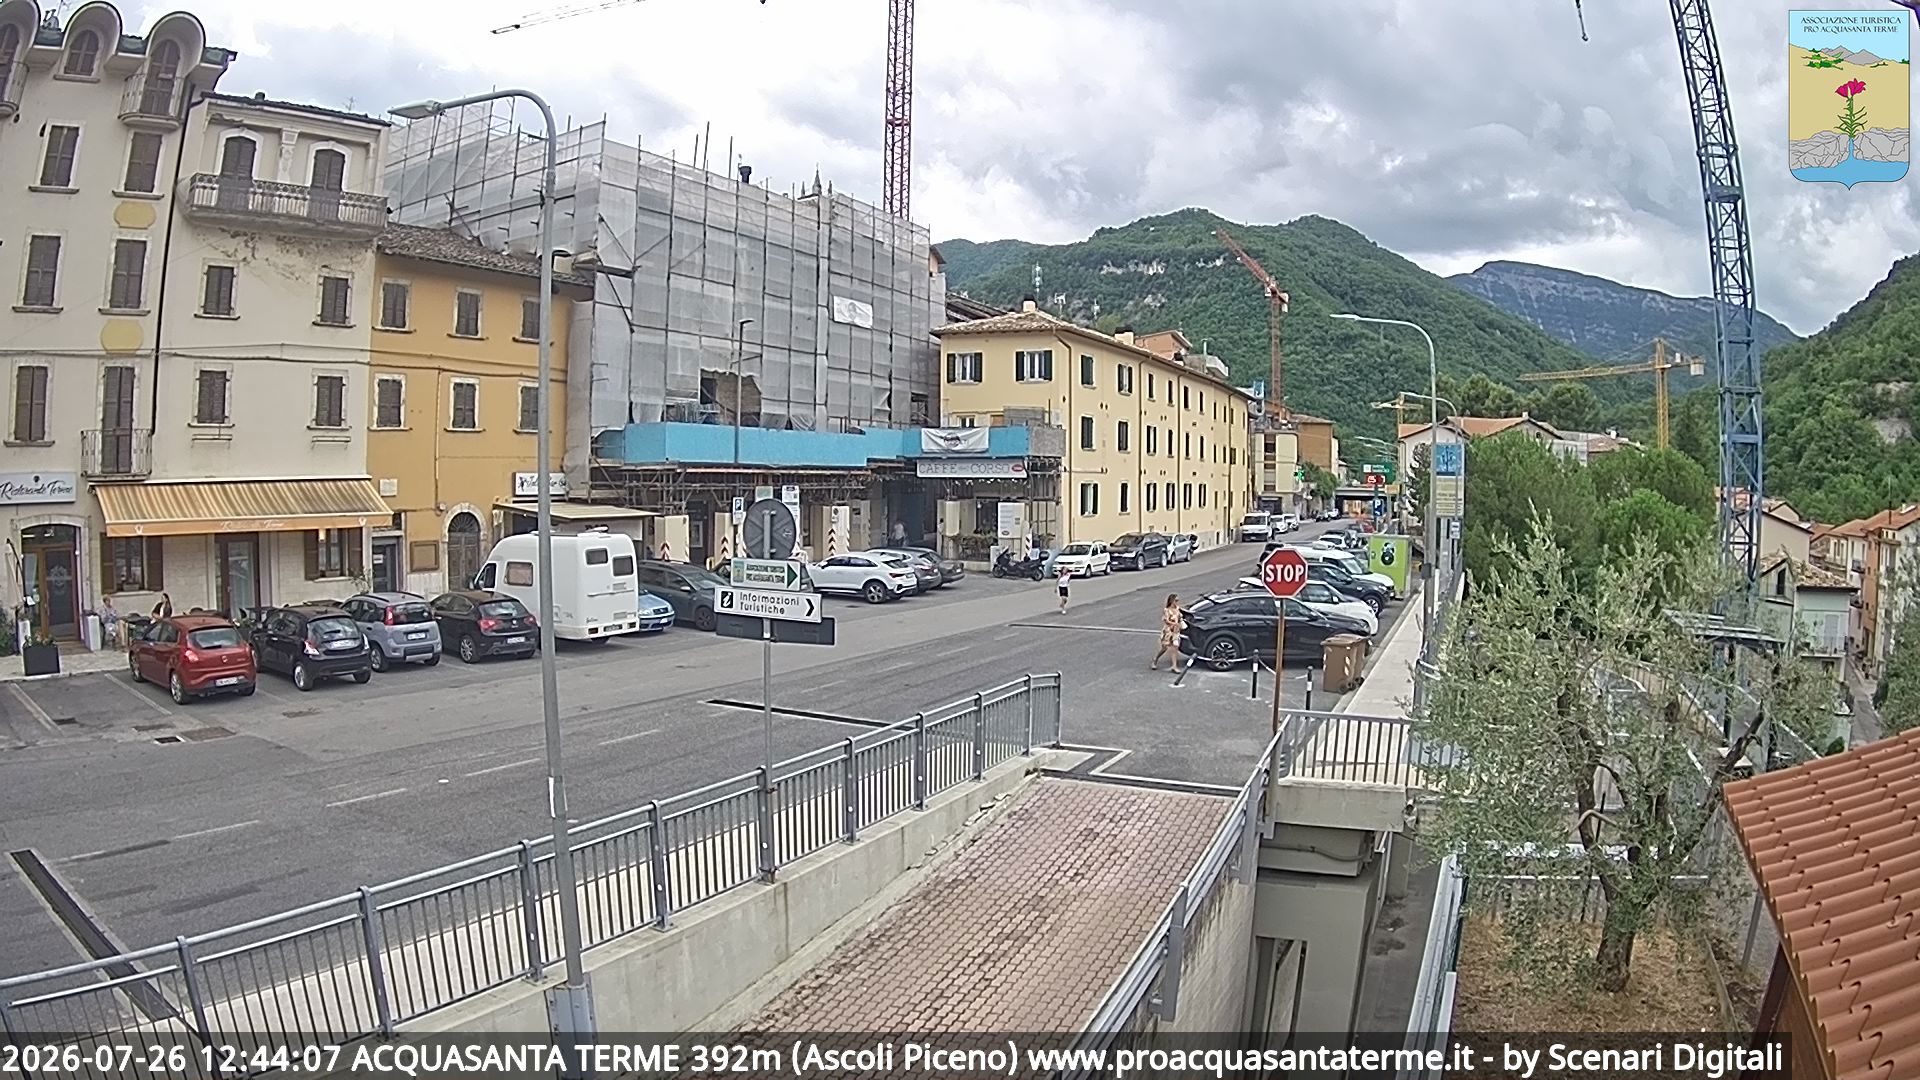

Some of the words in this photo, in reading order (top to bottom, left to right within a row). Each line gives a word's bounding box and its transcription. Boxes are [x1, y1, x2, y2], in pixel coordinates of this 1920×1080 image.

[971, 463, 1010, 474] CORSO
[1265, 564, 1304, 583] STOP
[740, 592, 800, 606] Informazioni
[740, 602, 785, 615] Turistiche
